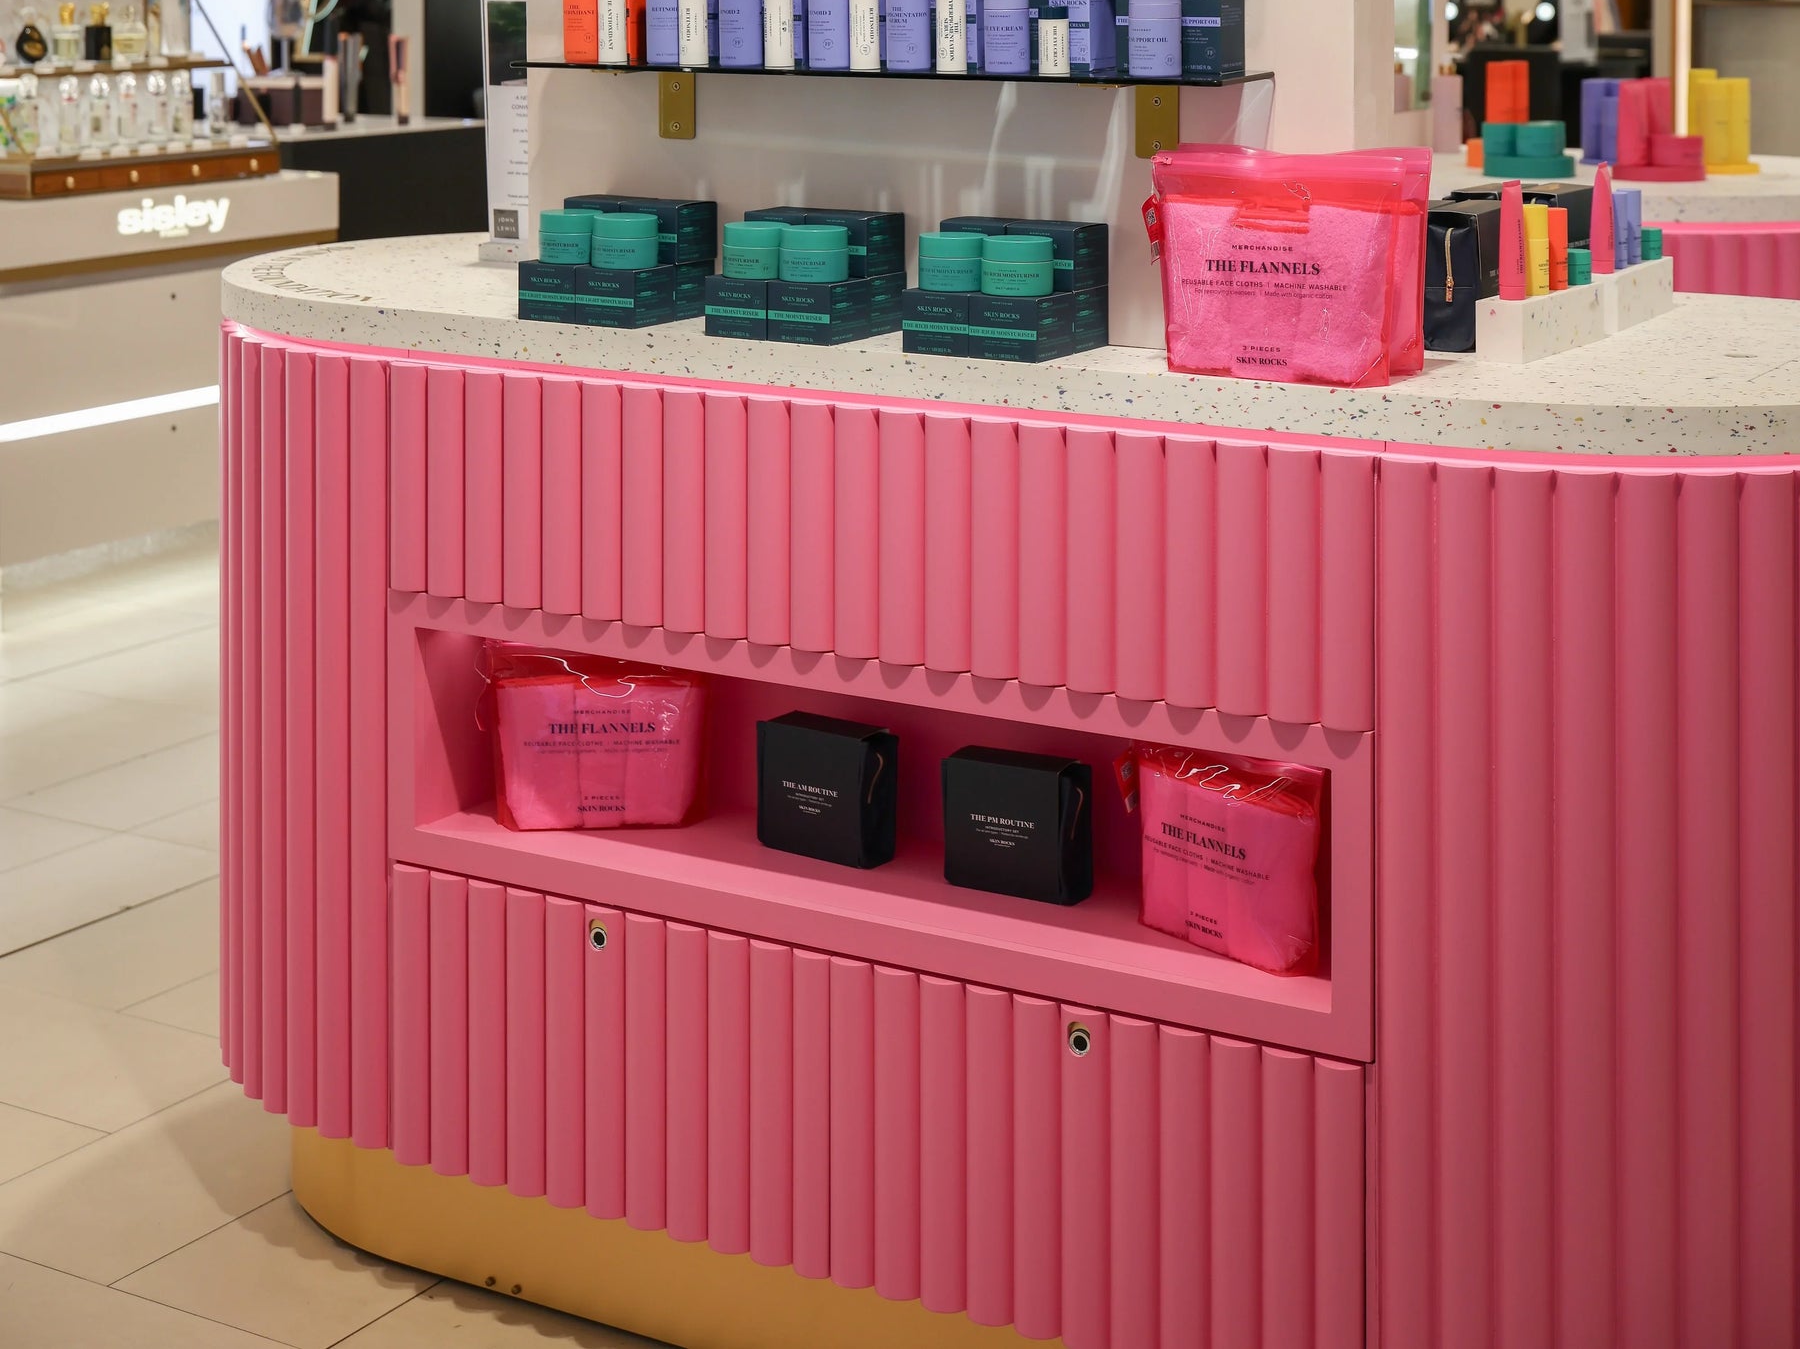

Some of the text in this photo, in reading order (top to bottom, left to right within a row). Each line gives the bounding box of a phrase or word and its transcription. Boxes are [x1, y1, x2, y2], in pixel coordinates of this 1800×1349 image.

[117, 194, 231, 236] sisley
[1231, 244, 1293, 252] MERCHANDISE
[1206, 259, 1321, 276] THE FLANNELS
[1308, 284, 1348, 292] WASHABLE
[721, 309, 759, 317] MOISTURISER
[933, 306, 953, 314] ROCKS
[784, 314, 823, 322] MOISTURISER
[929, 324, 967, 332] MOISTURISER
[997, 330, 1035, 338] MOISTURISER
[1236, 356, 1288, 366] SKIN ROCKS
[548, 722, 656, 735] THE FLANNELS
[782, 780, 838, 798] THE AM ROUTINE
[577, 805, 598, 813] SKIN
[970, 813, 1035, 829] THE PM ROUTINE
[1179, 813, 1226, 832] MERCHANDISE
[1161, 821, 1246, 861] THE FLANNELS
[1211, 859, 1235, 872] MACHINE
[1236, 865, 1270, 881] WASHABLE
[1184, 919, 1224, 939] SKIN ROCKS
